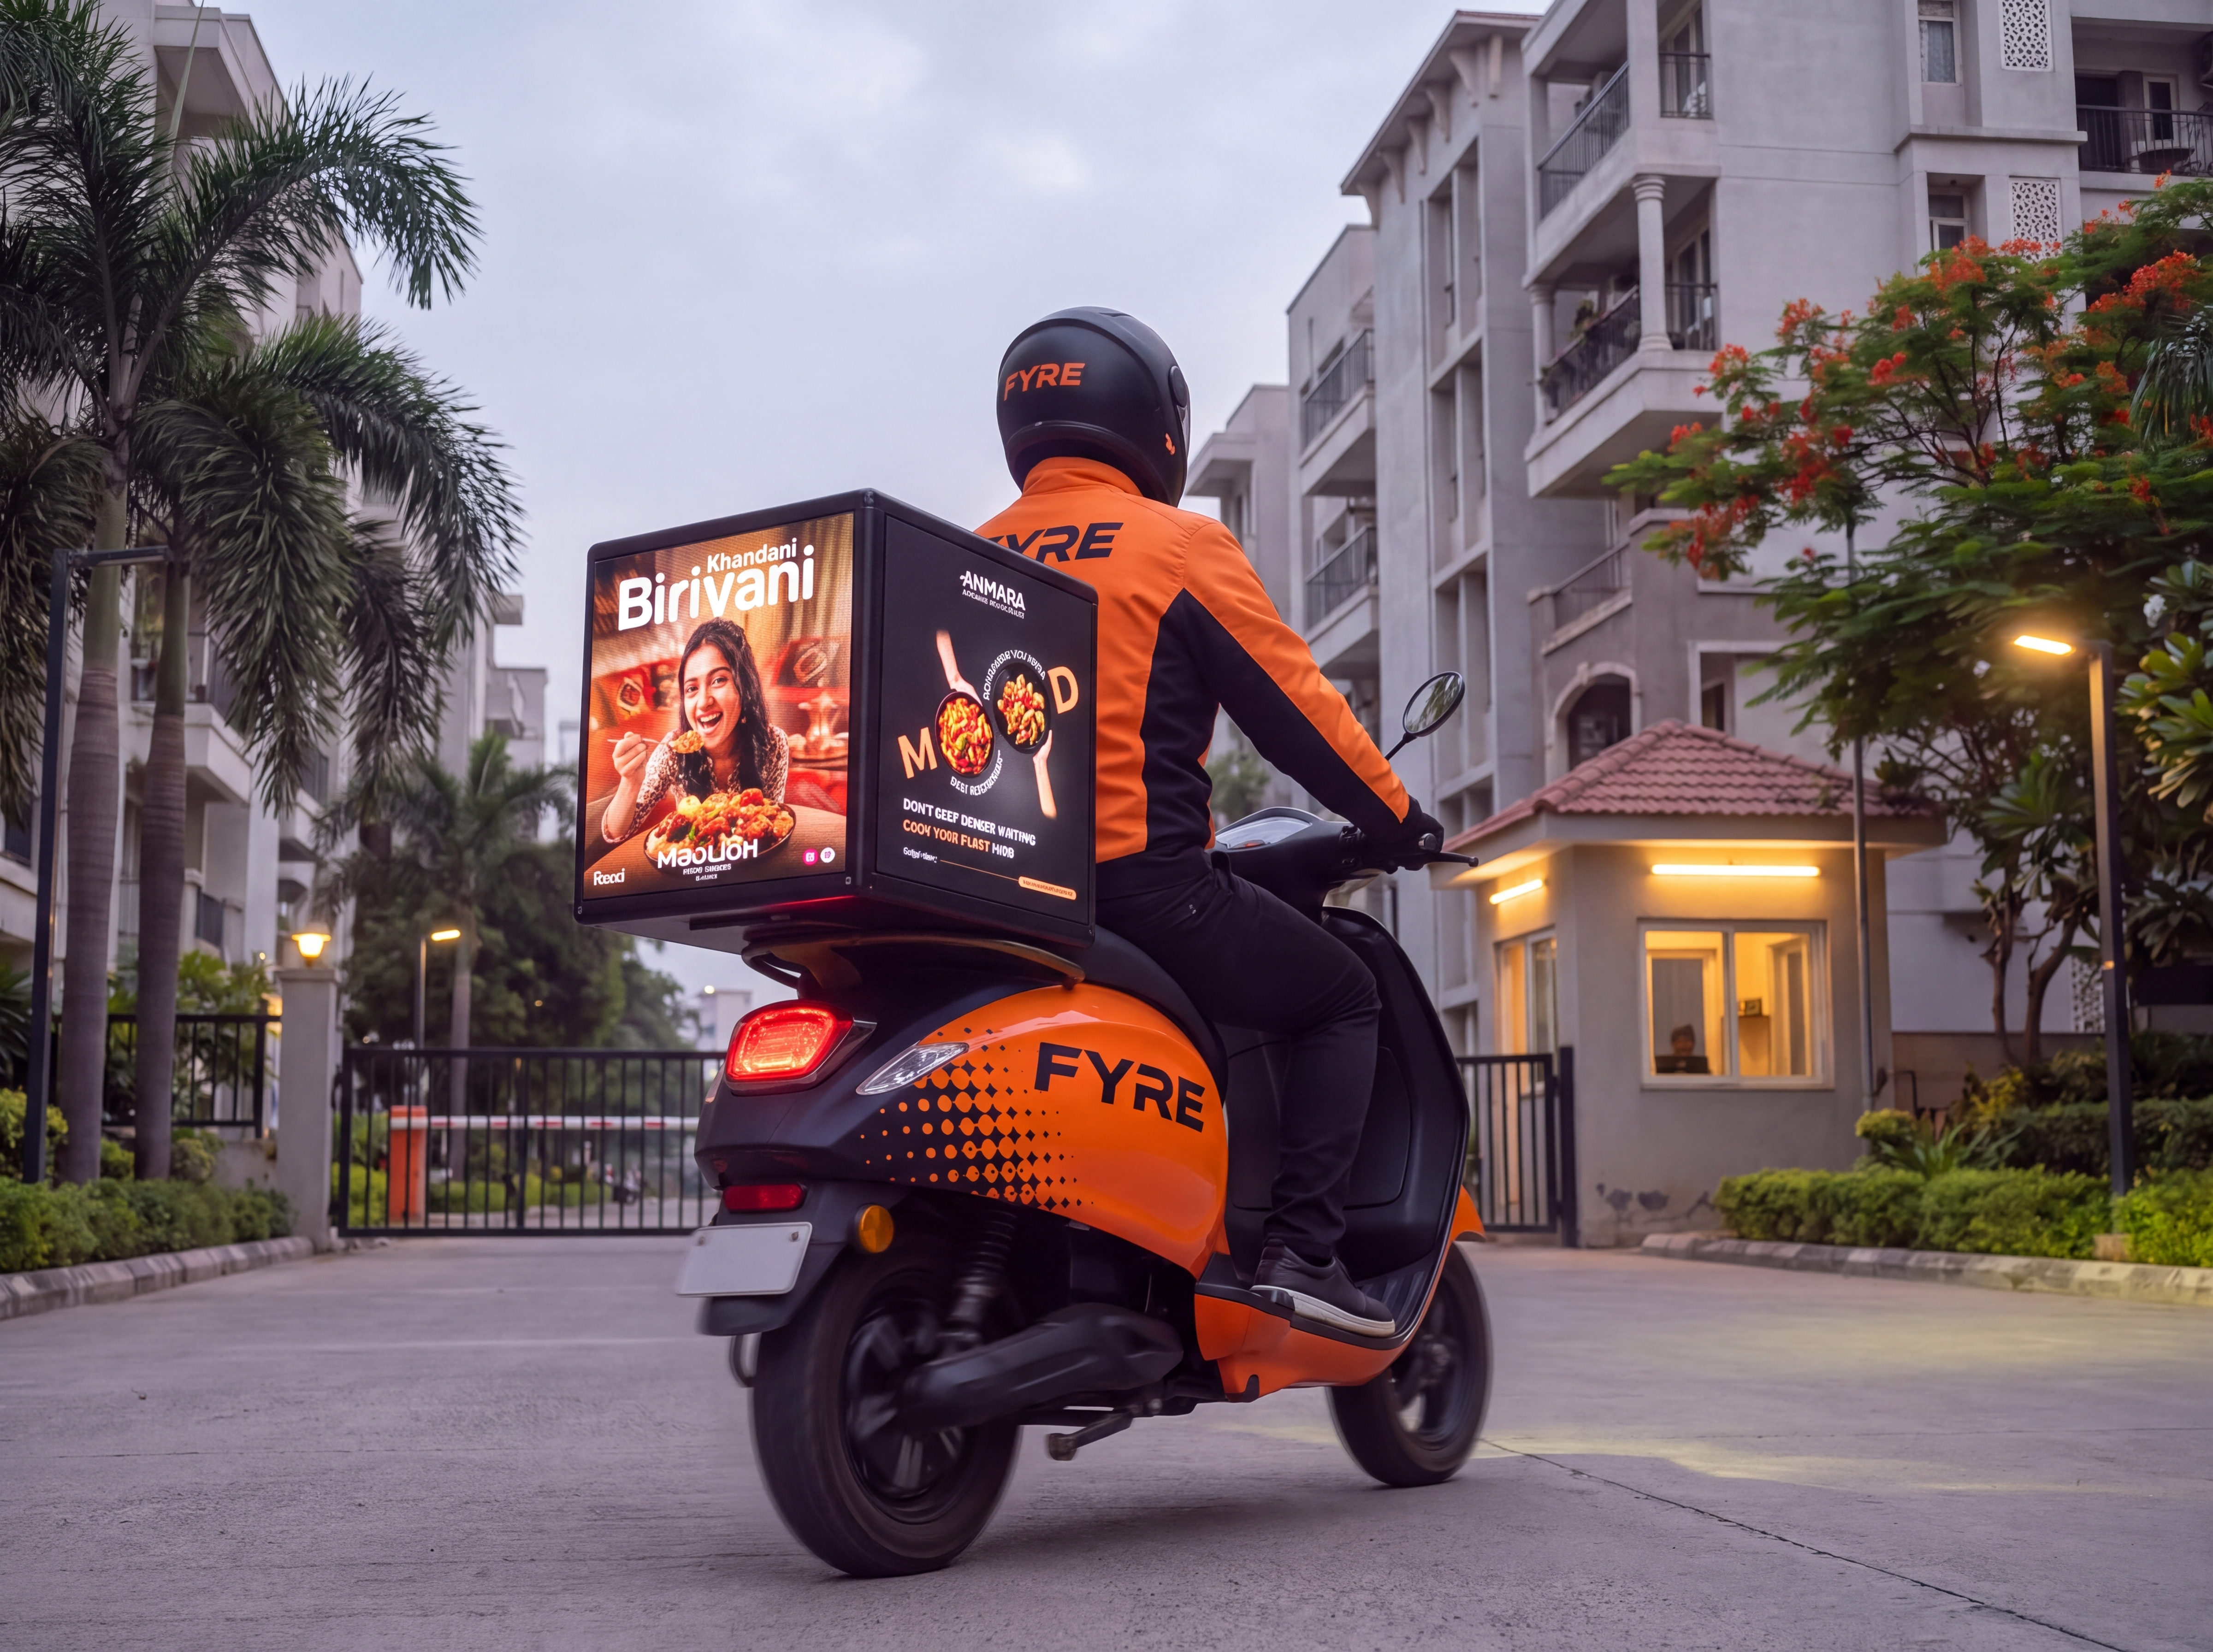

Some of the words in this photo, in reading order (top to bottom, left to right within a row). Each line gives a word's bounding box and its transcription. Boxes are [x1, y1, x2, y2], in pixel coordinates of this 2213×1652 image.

[1004, 363, 1085, 401] FYRE
[707, 537, 797, 573] Khandani
[988, 522, 1124, 564] YRE
[618, 544, 815, 631] Birivani
[1034, 1042, 1206, 1133] FYRE
